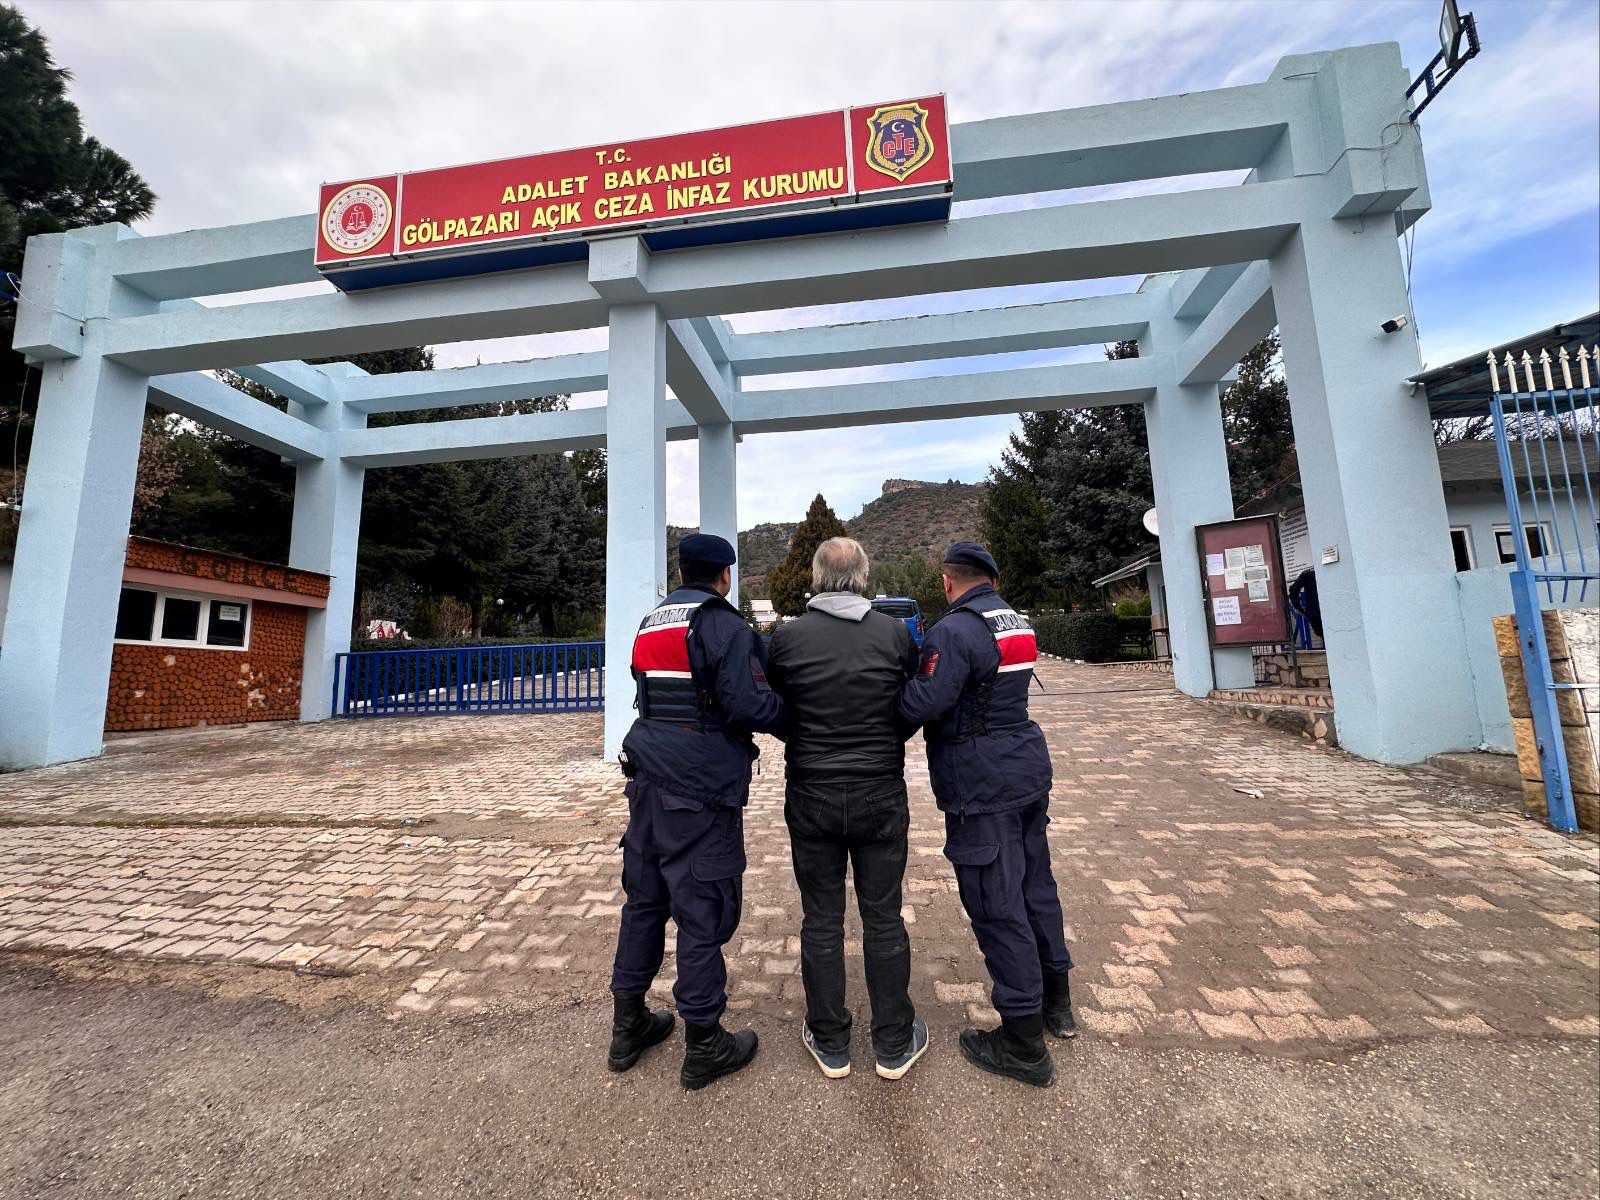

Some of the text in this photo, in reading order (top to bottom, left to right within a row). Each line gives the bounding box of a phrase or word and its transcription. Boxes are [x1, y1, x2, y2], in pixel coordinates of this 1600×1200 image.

[596, 148, 632, 166] T.C.
[882, 132, 916, 159] CTE
[501, 152, 732, 205] ADALET BAKANLIĞI
[403, 210, 520, 246] GÖLPAZARI
[531, 201, 582, 231] AÇIK
[594, 192, 655, 220] CEZA
[666, 182, 731, 211] İNFAZ
[743, 166, 844, 200] KURUMU
